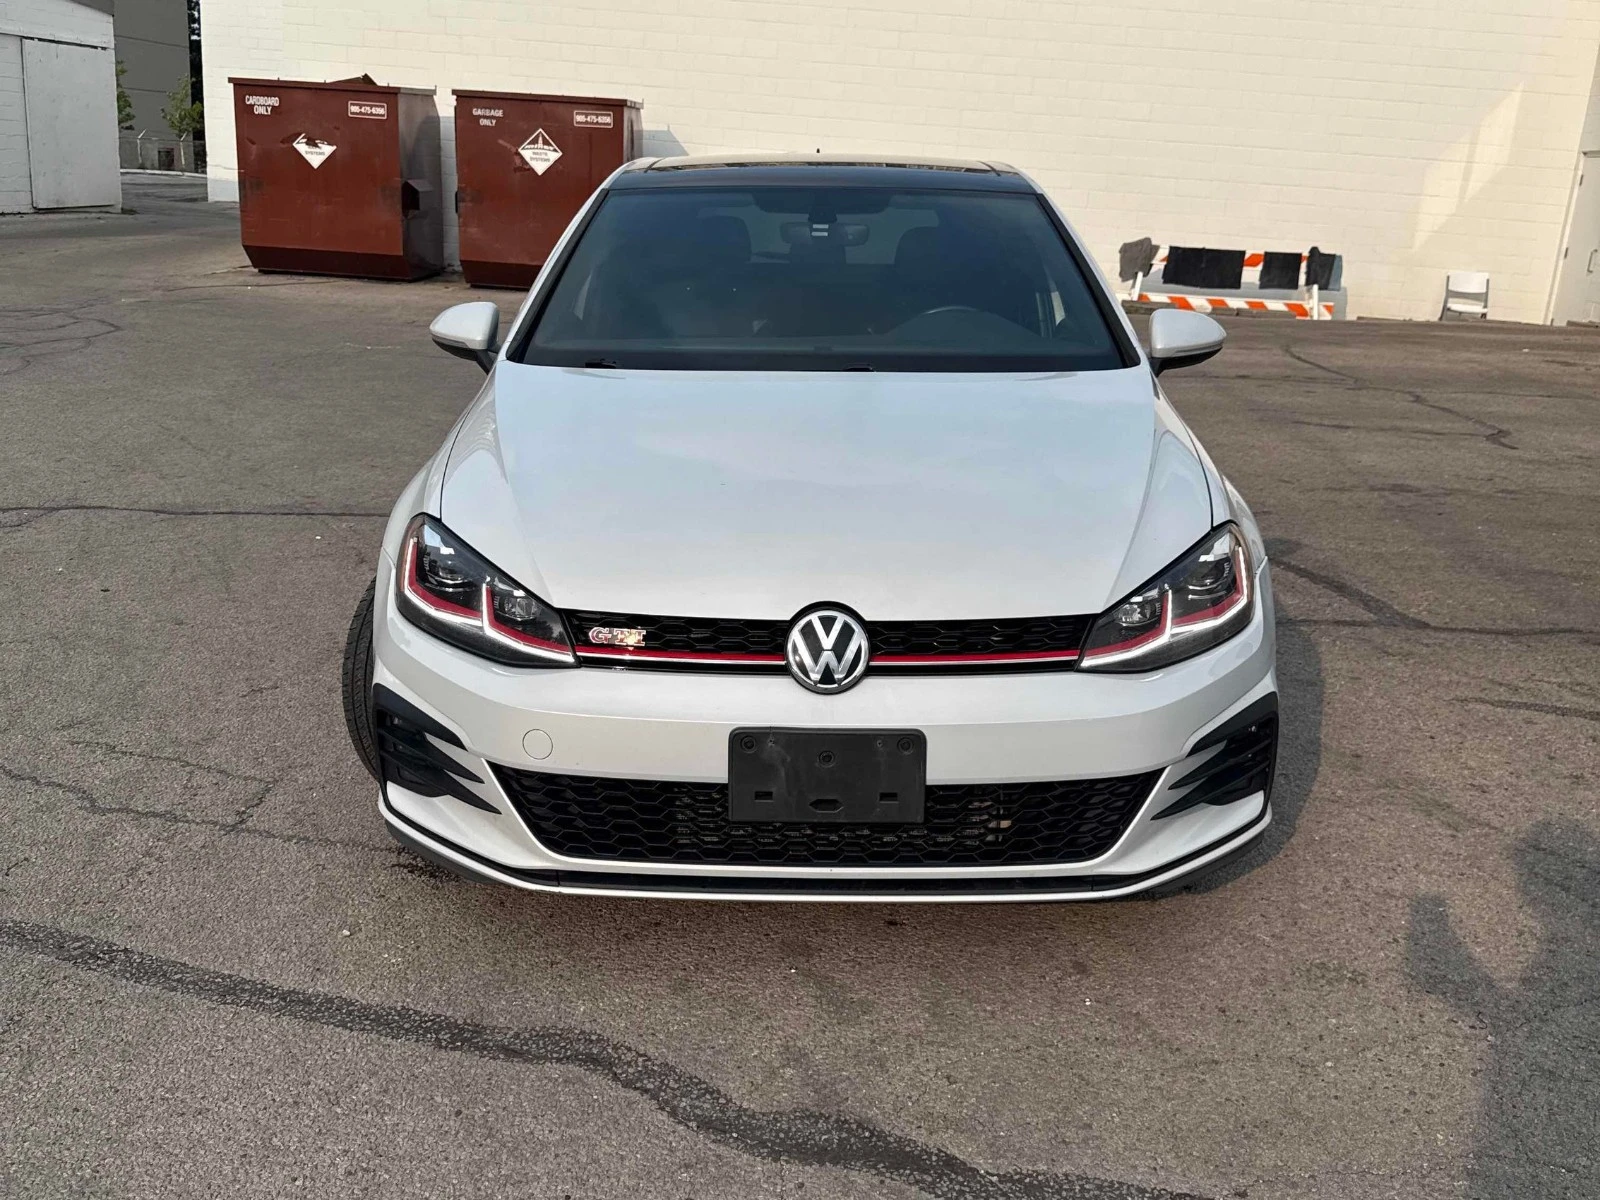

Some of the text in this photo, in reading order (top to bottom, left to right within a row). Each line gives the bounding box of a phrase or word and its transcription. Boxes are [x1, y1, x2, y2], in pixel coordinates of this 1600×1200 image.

[245, 95, 280, 107] CARDBOARD
[253, 105, 272, 115] ONLY
[350, 105, 386, 115] 905-475-6356
[472, 108, 504, 117] GARBAGE
[479, 118, 497, 126] ONLY
[588, 626, 647, 646] GTI
